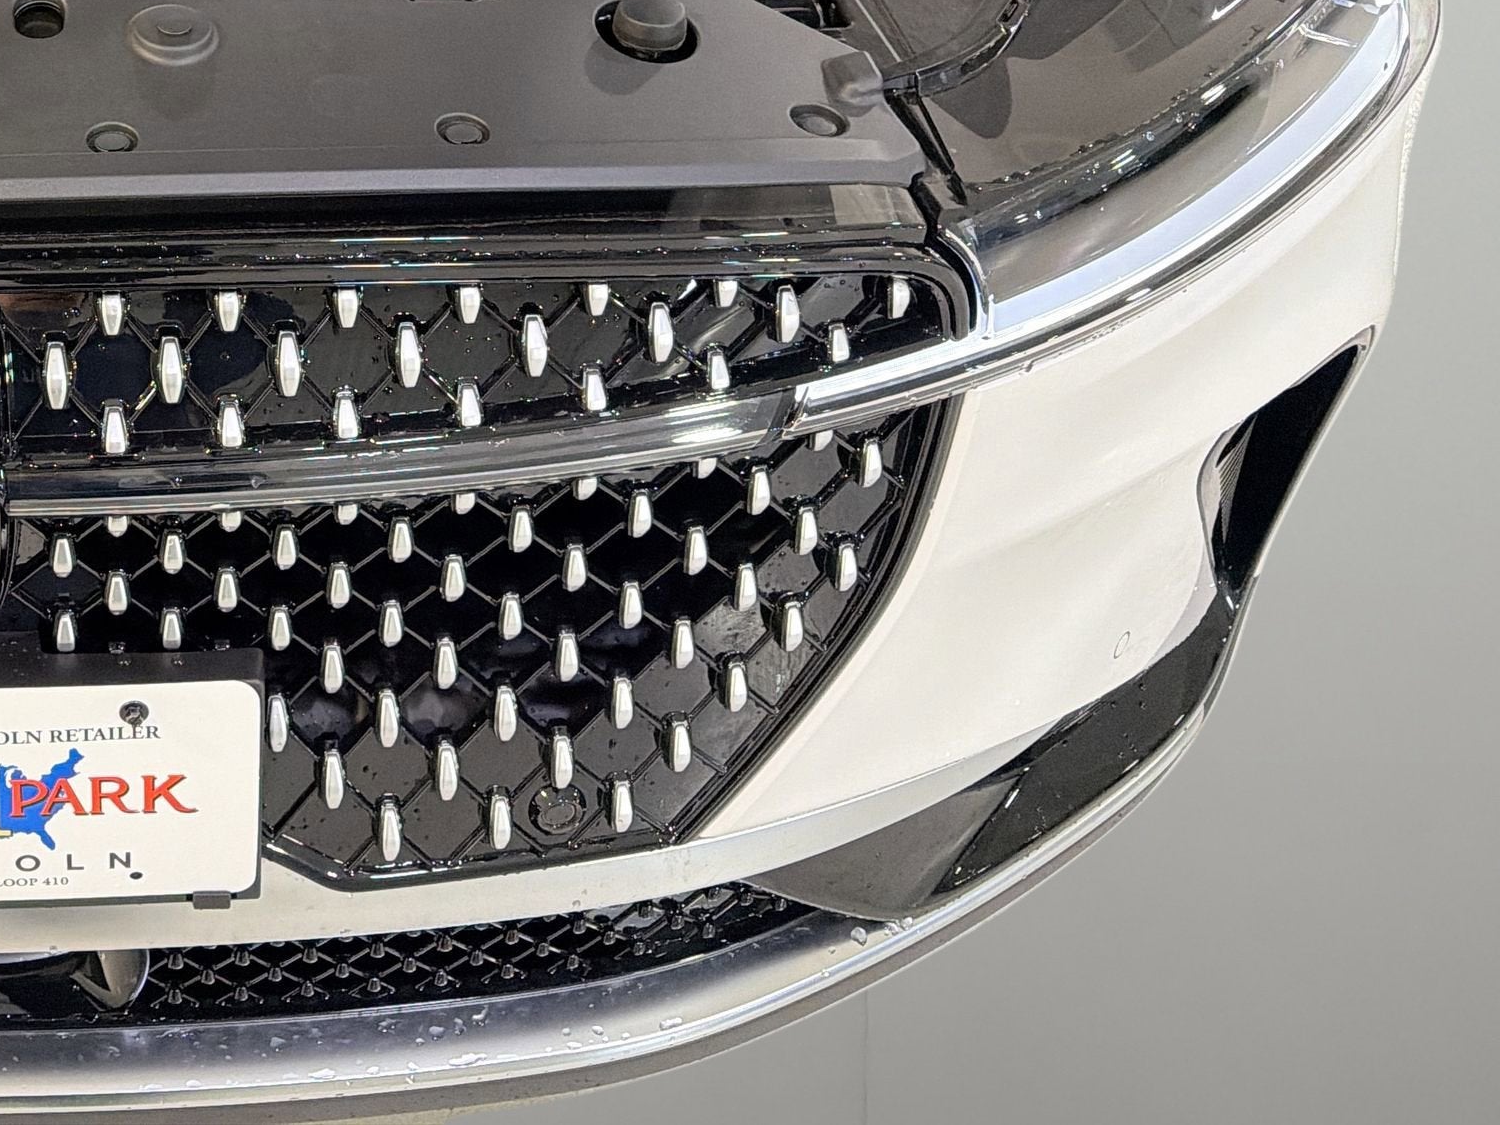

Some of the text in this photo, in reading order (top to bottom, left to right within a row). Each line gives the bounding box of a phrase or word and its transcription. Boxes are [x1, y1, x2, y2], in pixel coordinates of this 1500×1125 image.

[48, 725, 161, 744] RETAILER
[8, 773, 200, 817] PARK
[41, 876, 70, 887] 410
